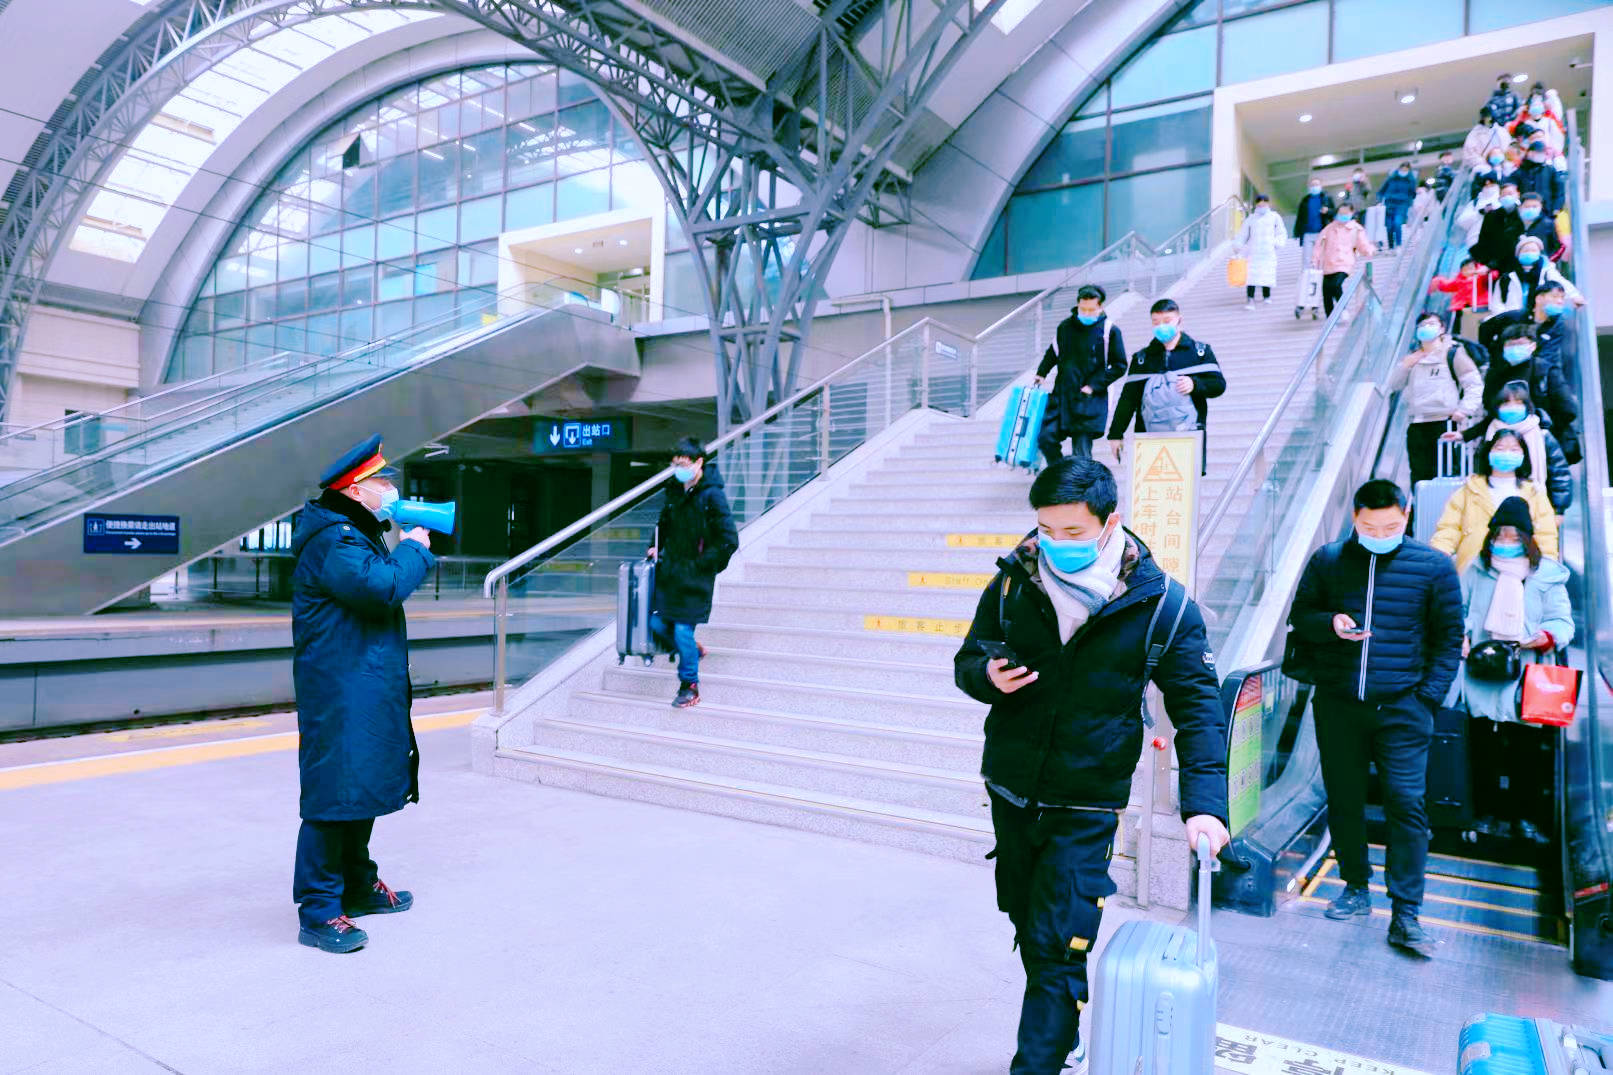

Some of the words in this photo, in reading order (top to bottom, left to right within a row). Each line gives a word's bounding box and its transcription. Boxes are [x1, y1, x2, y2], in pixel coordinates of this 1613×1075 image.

[582, 424, 610, 437] 出站口
[1243, 1032, 1318, 1057] CLEAR
[1335, 1057, 1395, 1075] KEEP
